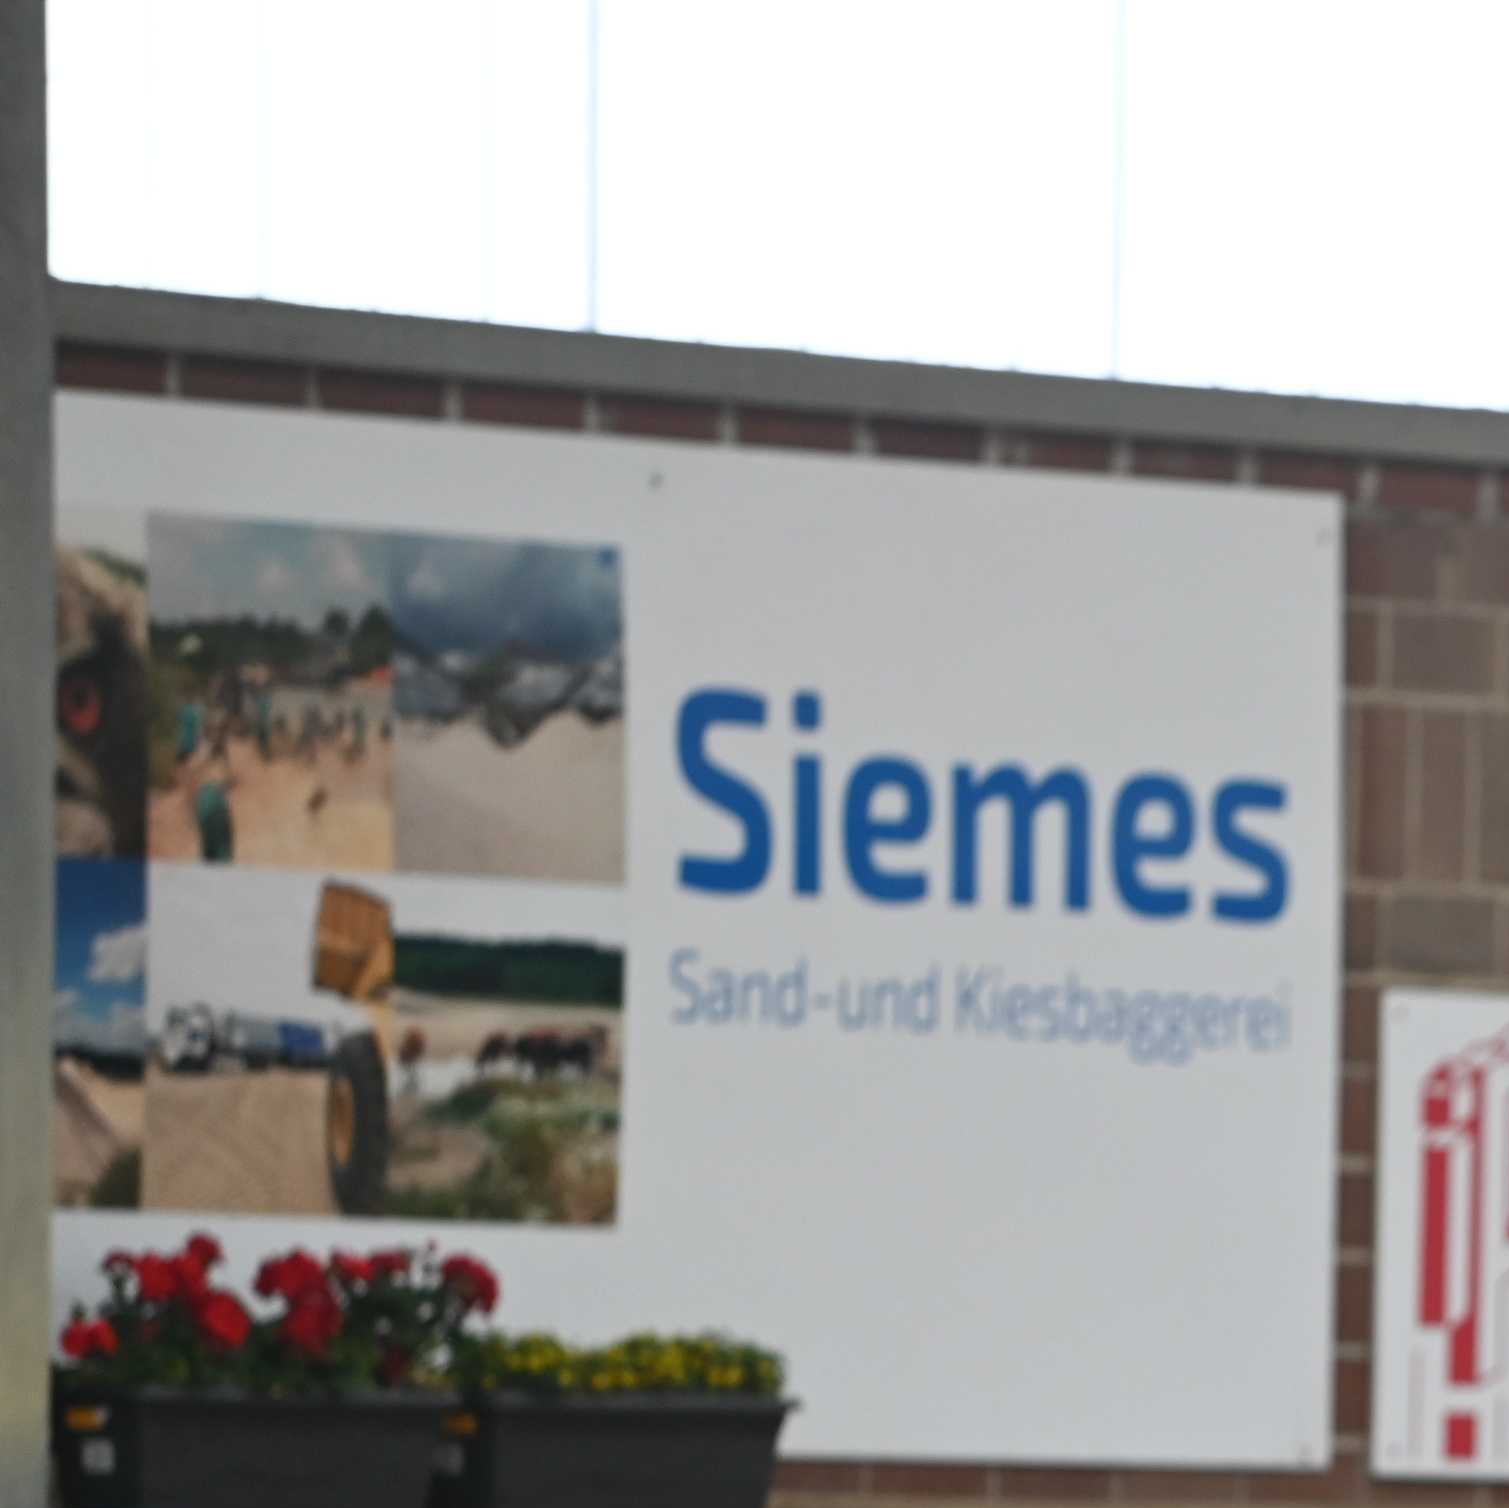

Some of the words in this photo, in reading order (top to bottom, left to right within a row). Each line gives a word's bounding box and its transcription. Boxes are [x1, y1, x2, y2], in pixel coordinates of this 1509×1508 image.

[674, 685, 1293, 926] Siemes
[668, 946, 942, 1036] Sand-und
[953, 966, 1293, 1067] Kiesbaggerei
